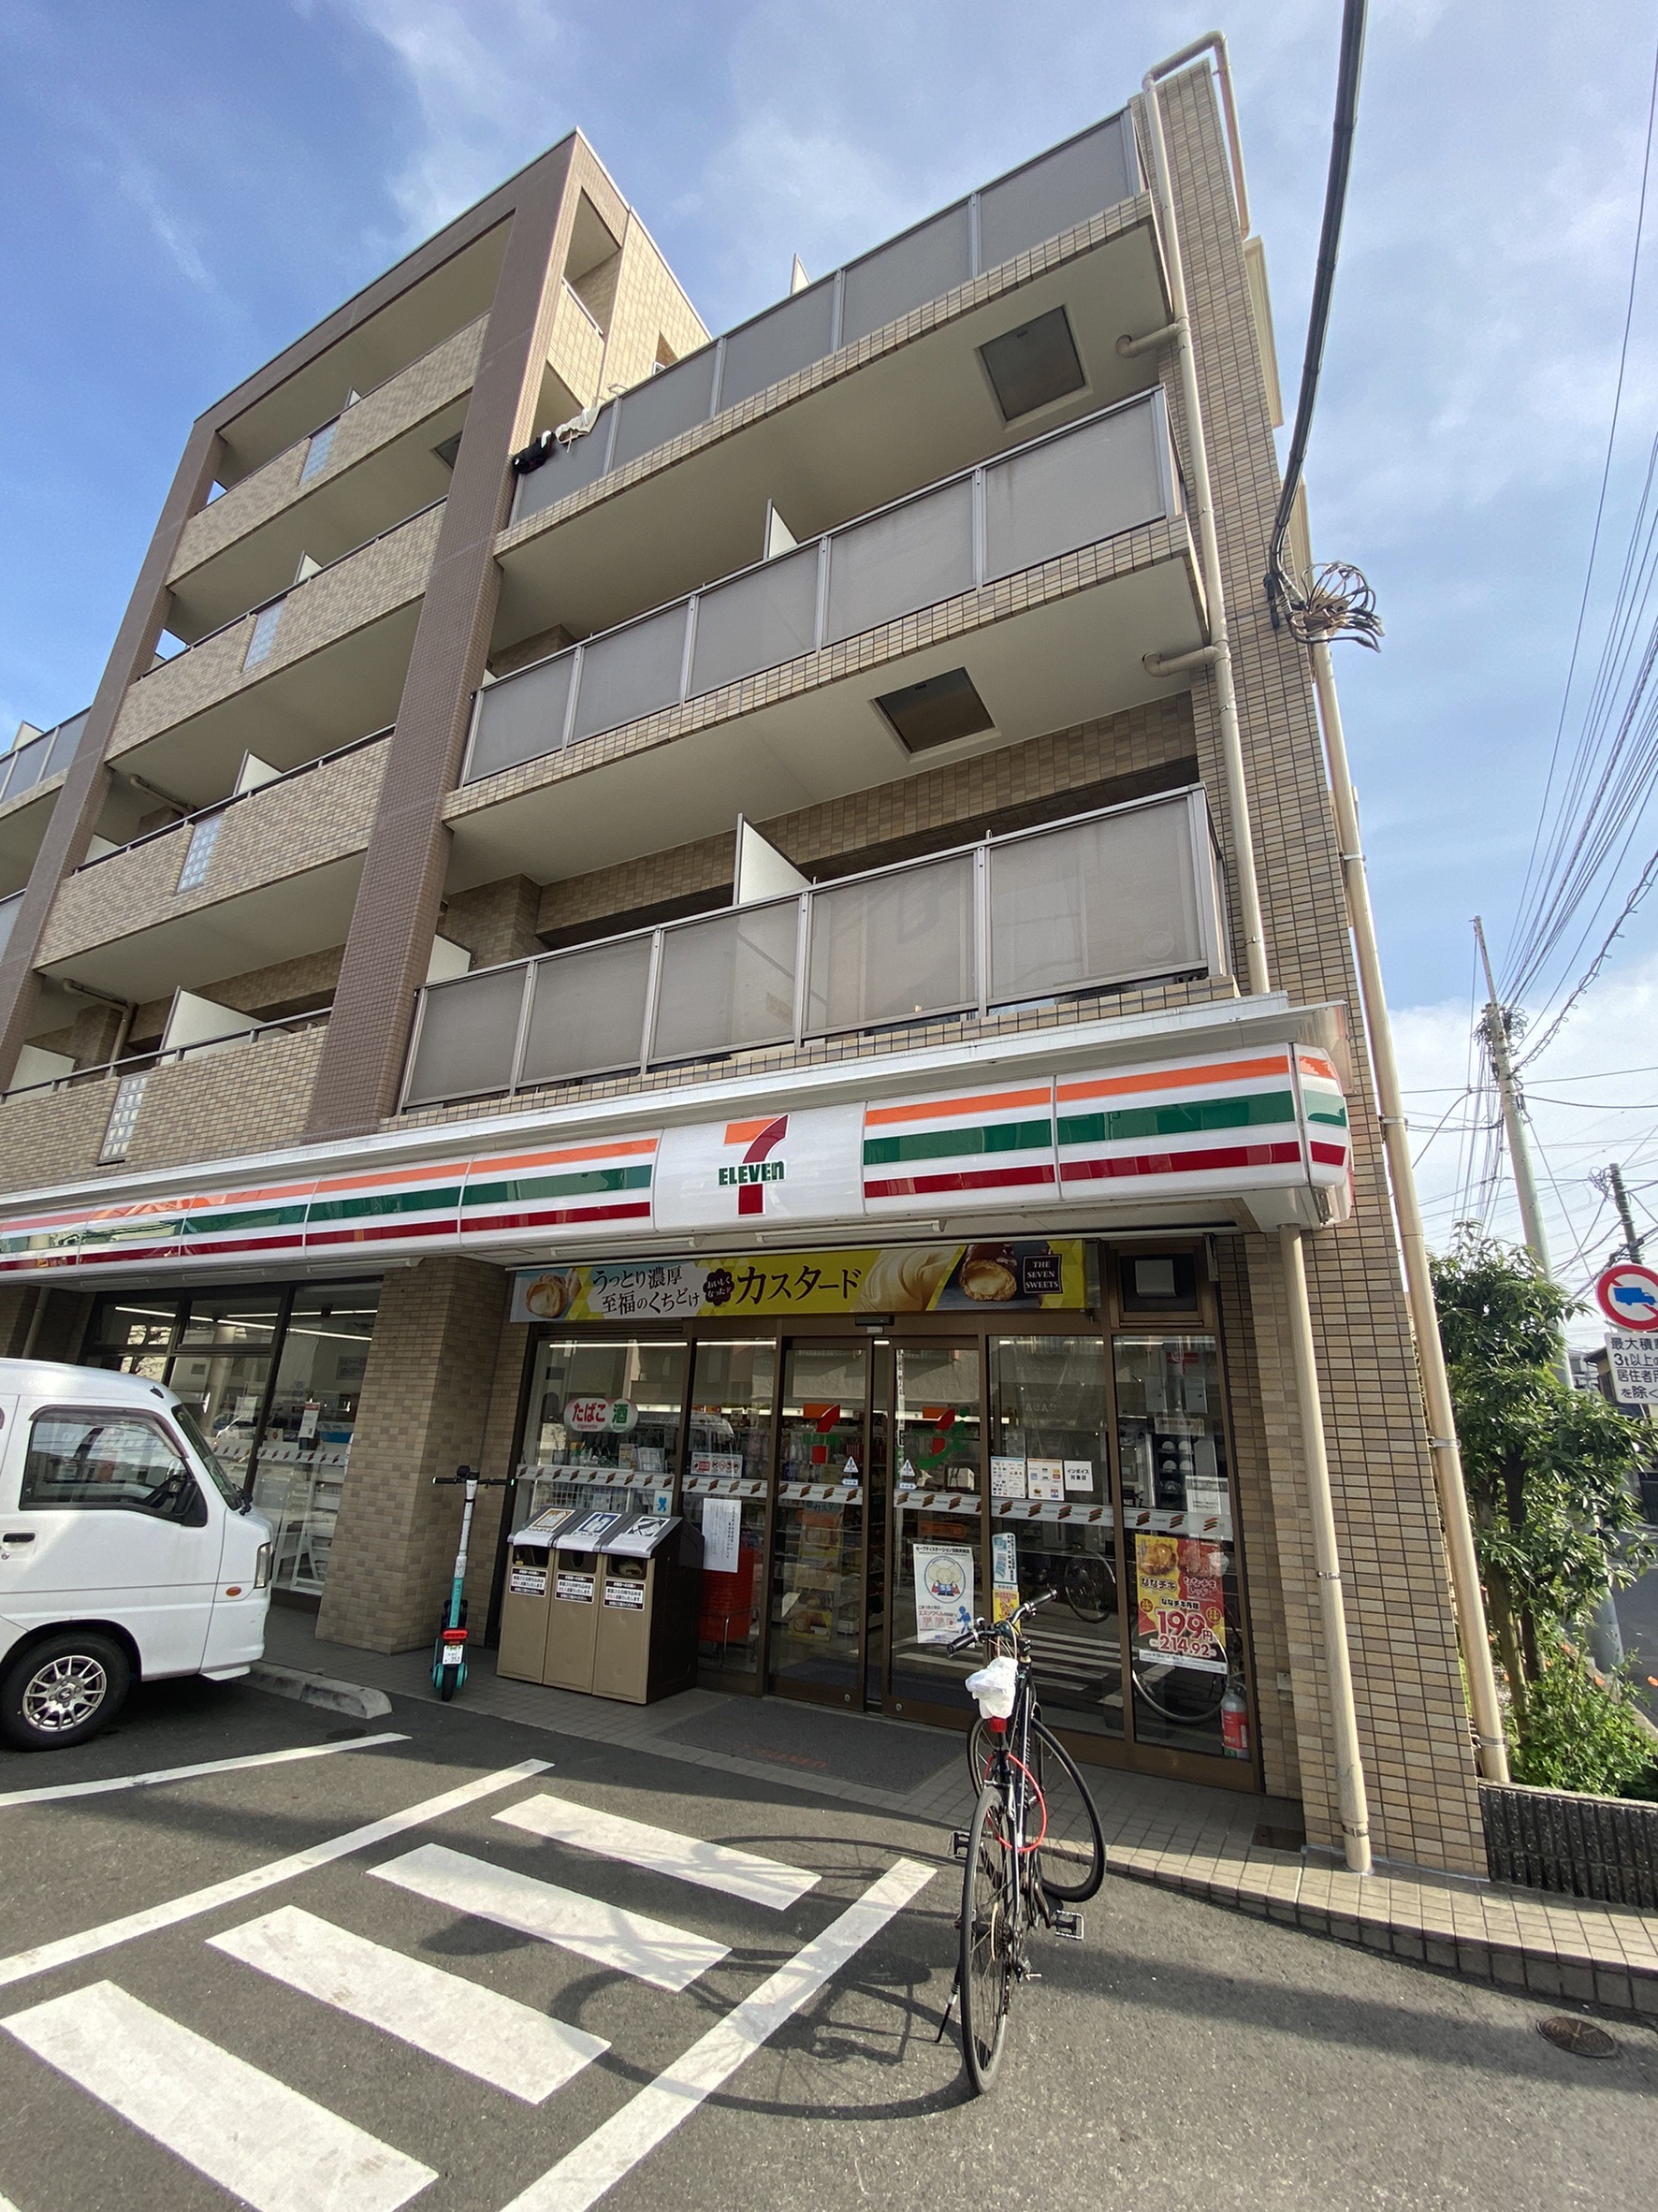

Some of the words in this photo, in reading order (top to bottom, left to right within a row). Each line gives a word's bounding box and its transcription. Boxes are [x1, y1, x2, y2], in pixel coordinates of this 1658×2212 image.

[723, 1113, 789, 1215] 7
[592, 1265, 683, 1295] うっとり濃厚
[734, 1265, 863, 1305] カスタード
[1026, 1270, 1055, 1278] SEVEN
[601, 1288, 701, 1316] 至福のくちどけ
[1621, 1385, 1658, 1399] を除く
[572, 1402, 606, 1422] たばこ
[611, 1404, 629, 1423] 酒
[1141, 1577, 1177, 1591] ななチキ
